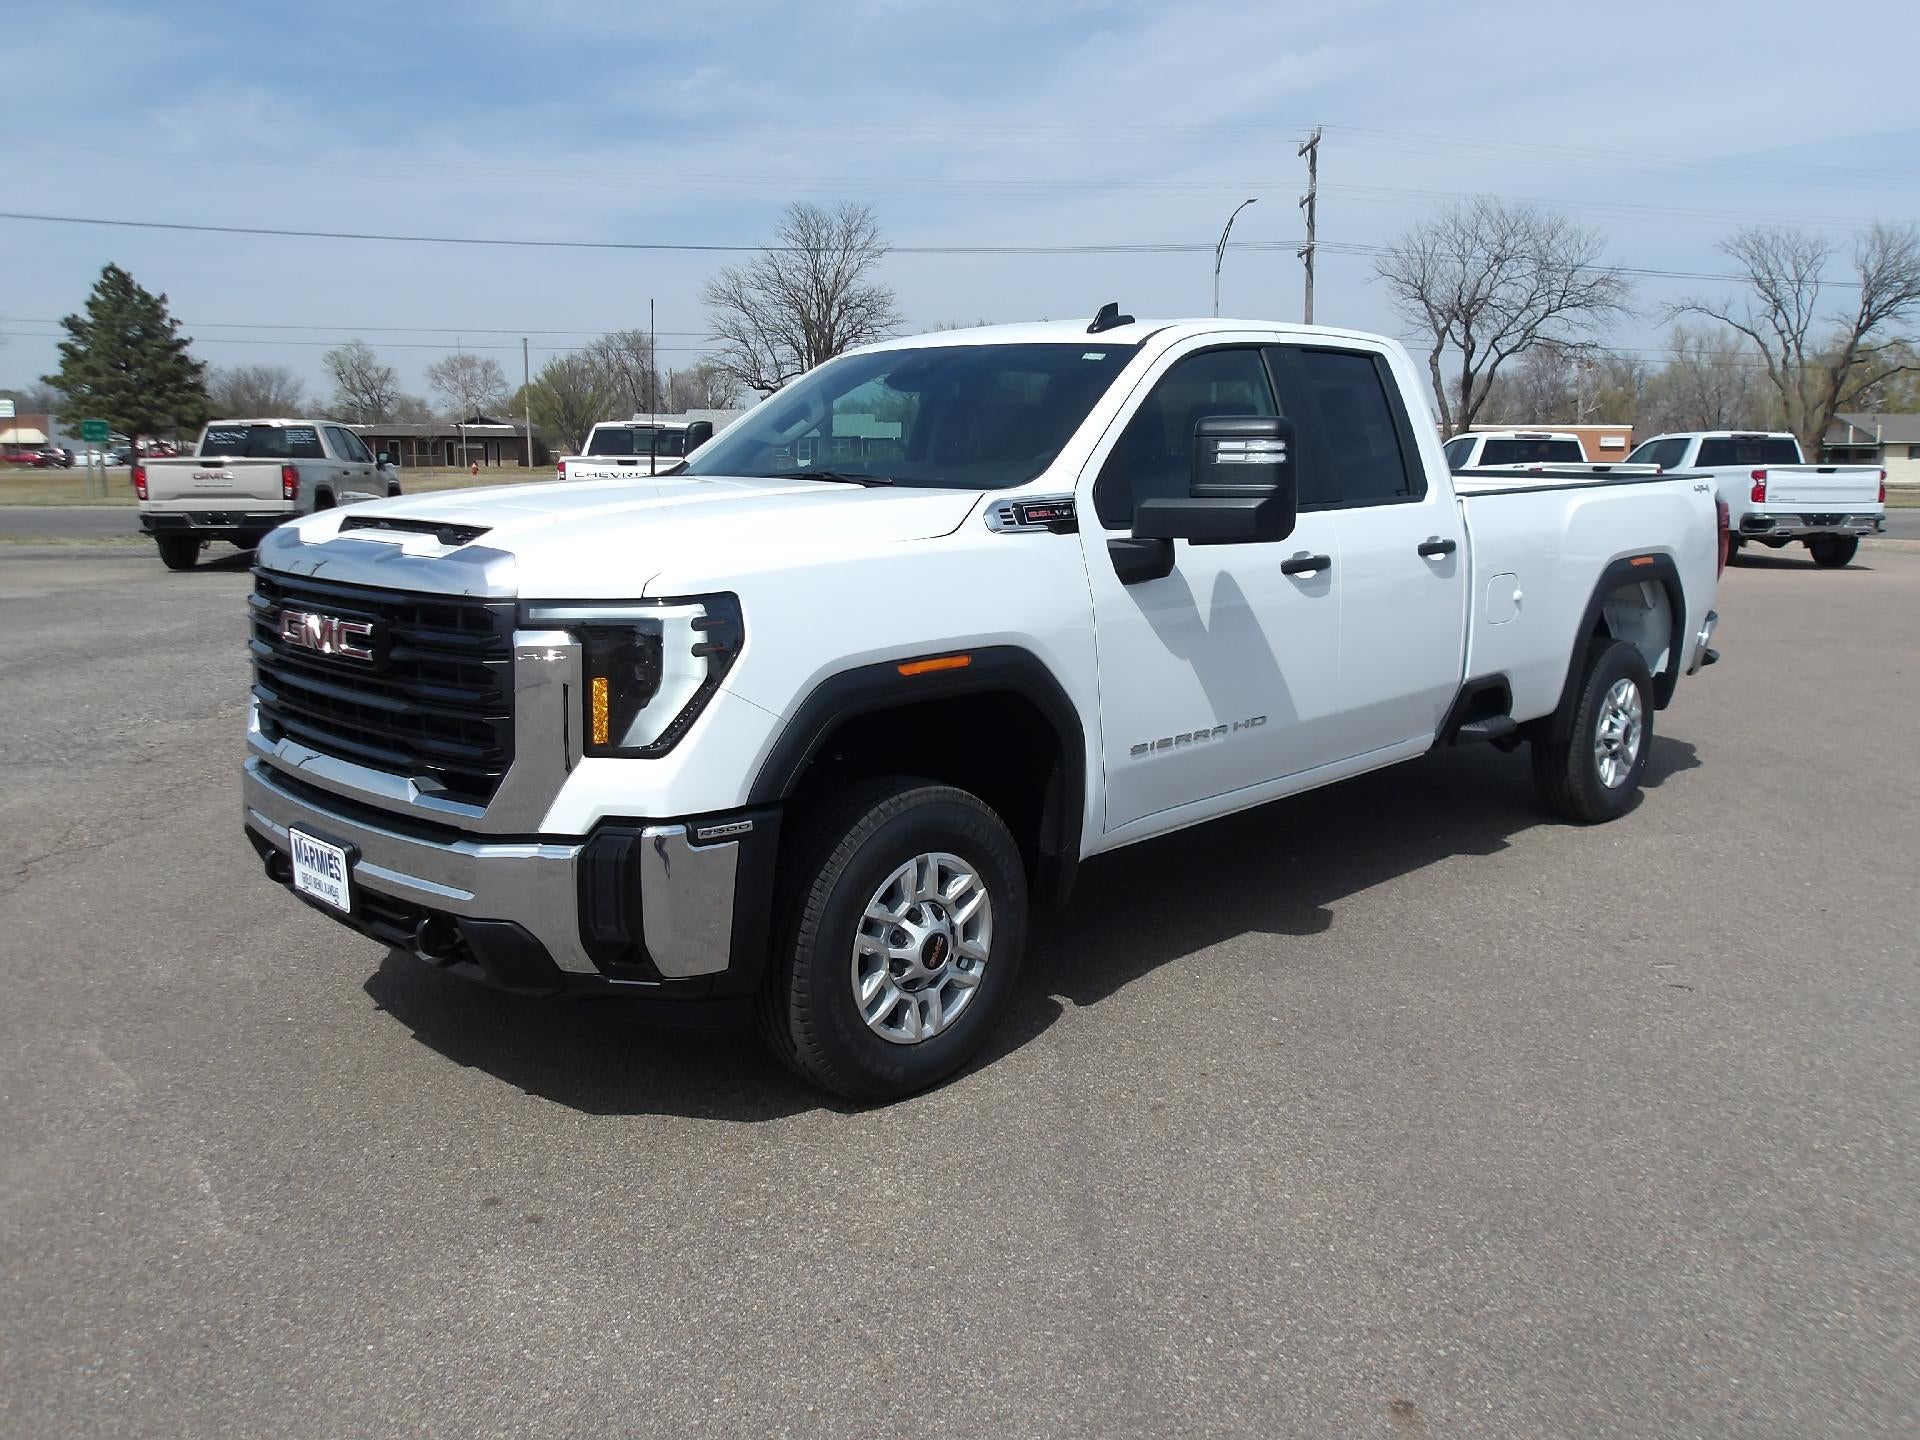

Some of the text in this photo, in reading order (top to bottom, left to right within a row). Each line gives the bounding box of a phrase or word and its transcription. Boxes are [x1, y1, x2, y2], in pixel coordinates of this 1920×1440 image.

[279, 609, 373, 661] GMC
[1130, 715, 1267, 756] SIERRA HD
[928, 936, 944, 967] GMC
